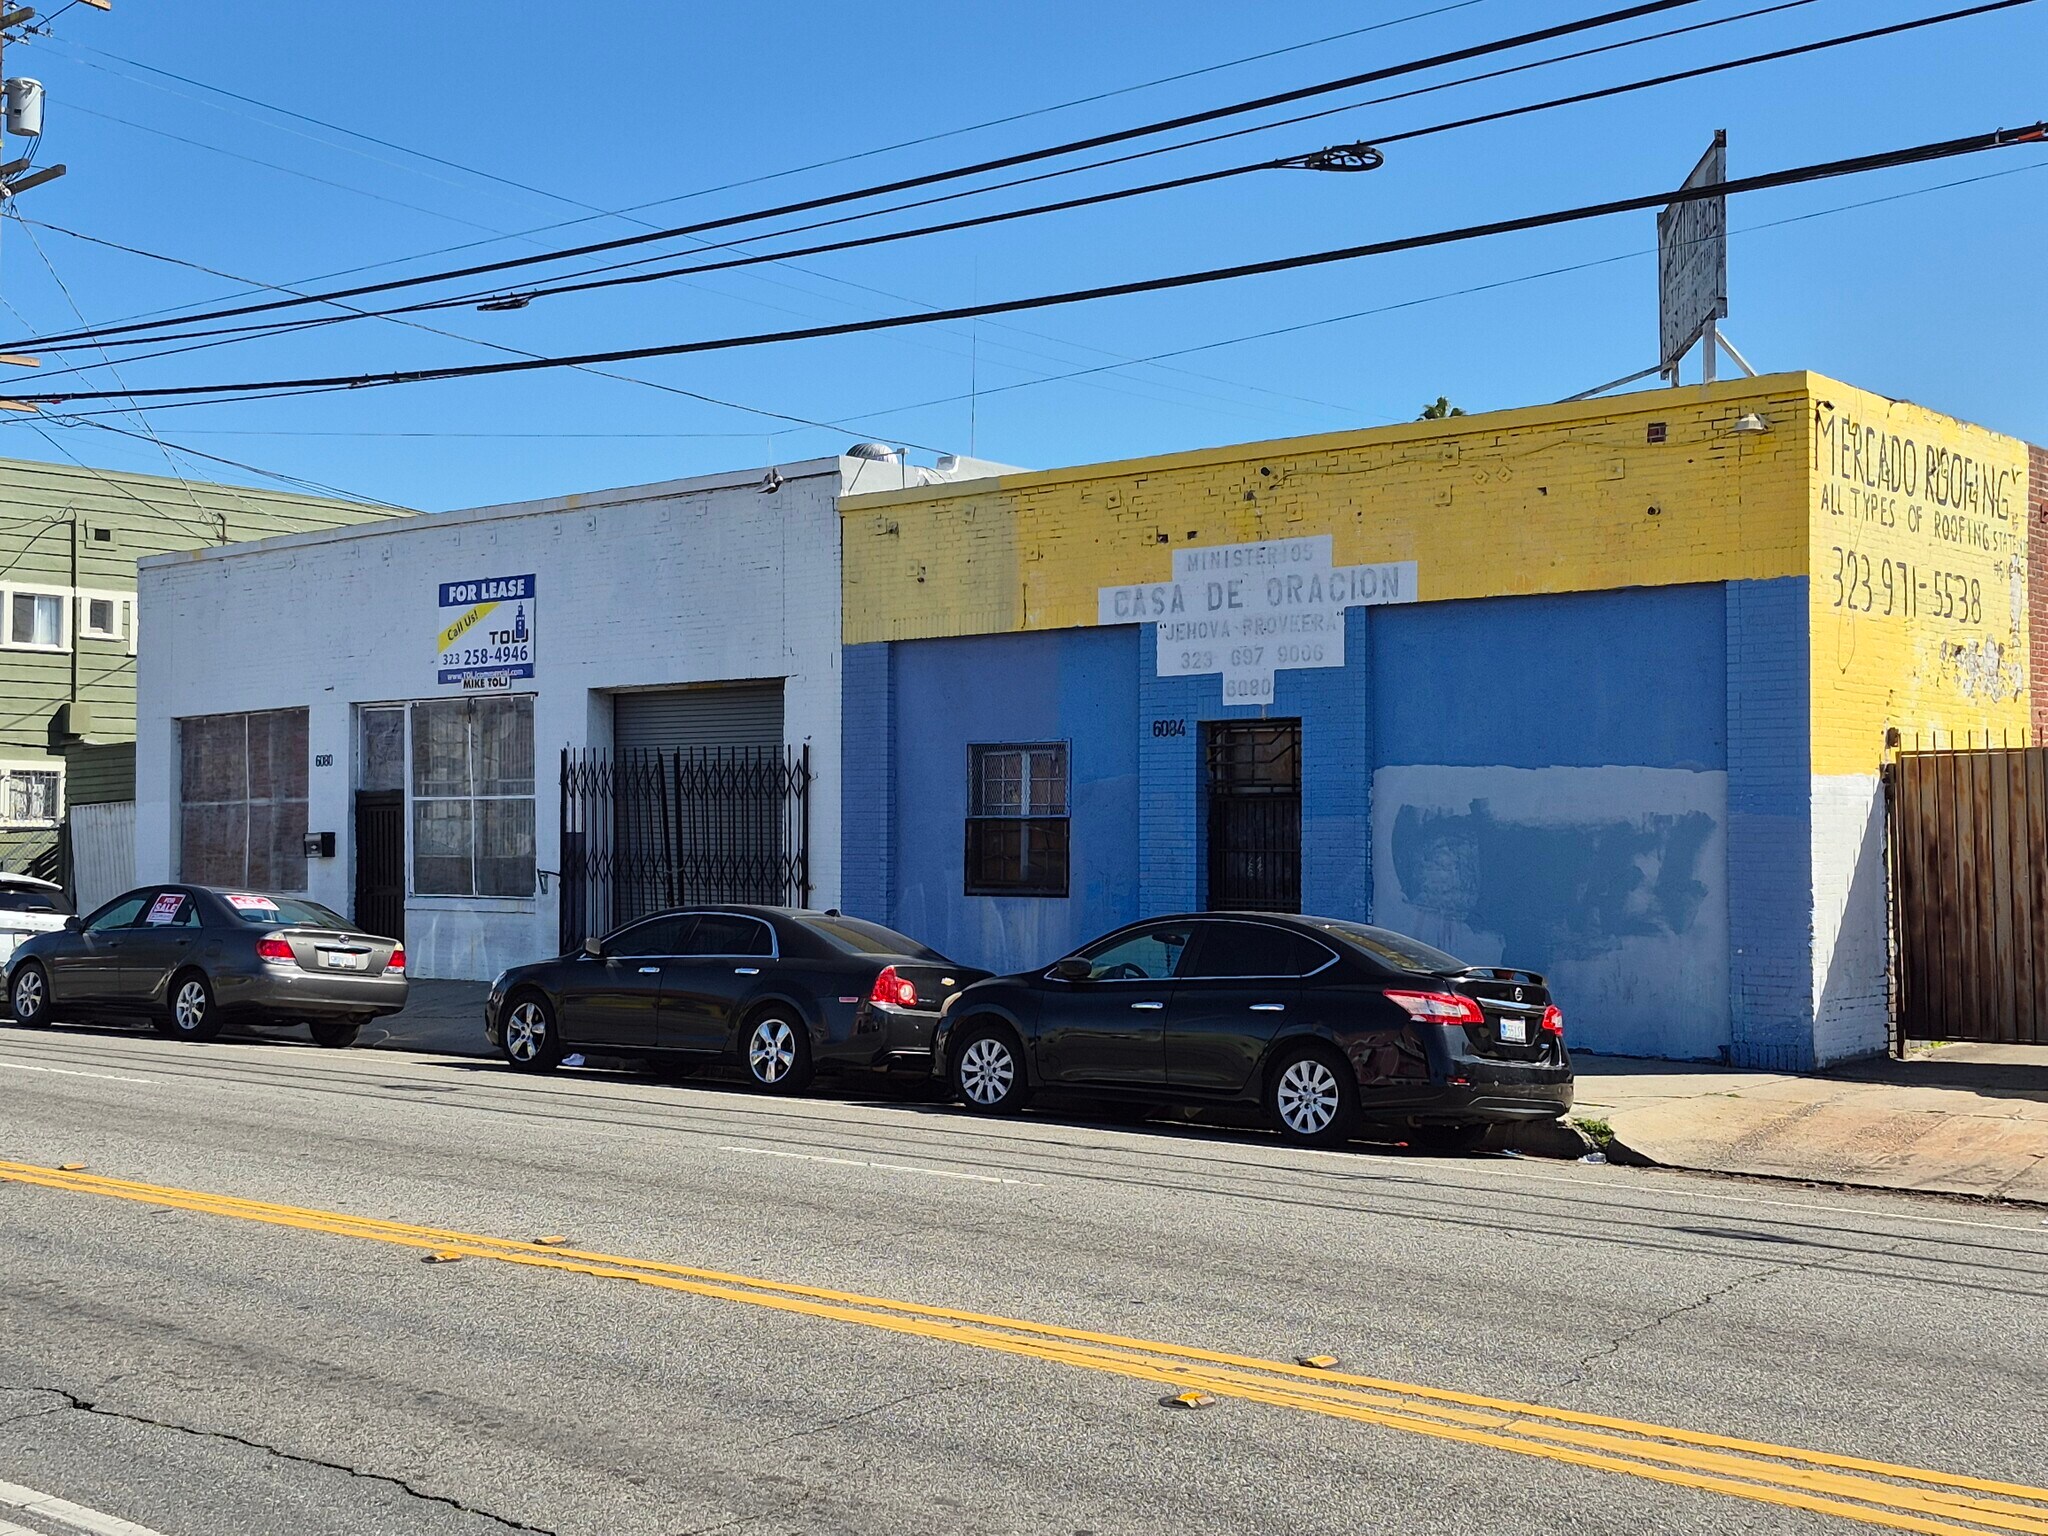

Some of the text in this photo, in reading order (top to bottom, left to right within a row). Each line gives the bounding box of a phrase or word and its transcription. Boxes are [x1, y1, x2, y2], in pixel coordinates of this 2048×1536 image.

[1815, 409, 2009, 521] MERCADO ROOFING
[1821, 483, 1844, 515] ALL
[1850, 487, 1896, 528] TYPES
[1908, 504, 1922, 532] OF
[1934, 511, 1990, 551] ROOFING
[1187, 543, 1313, 572] MINISTERIOS
[448, 579, 525, 603] FOR LEASE
[1113, 566, 1400, 618] CASA DE ORACION
[1832, 545, 1982, 624] 323 971-5538
[447, 610, 479, 641] Call Us!
[443, 645, 529, 666] 323 258-4946
[1181, 651, 1213, 669] 323
[463, 677, 508, 689] MIKE TOLJ
[1153, 719, 1186, 737] 6084
[315, 754, 333, 767] 6080
[154, 902, 178, 913] SALE
